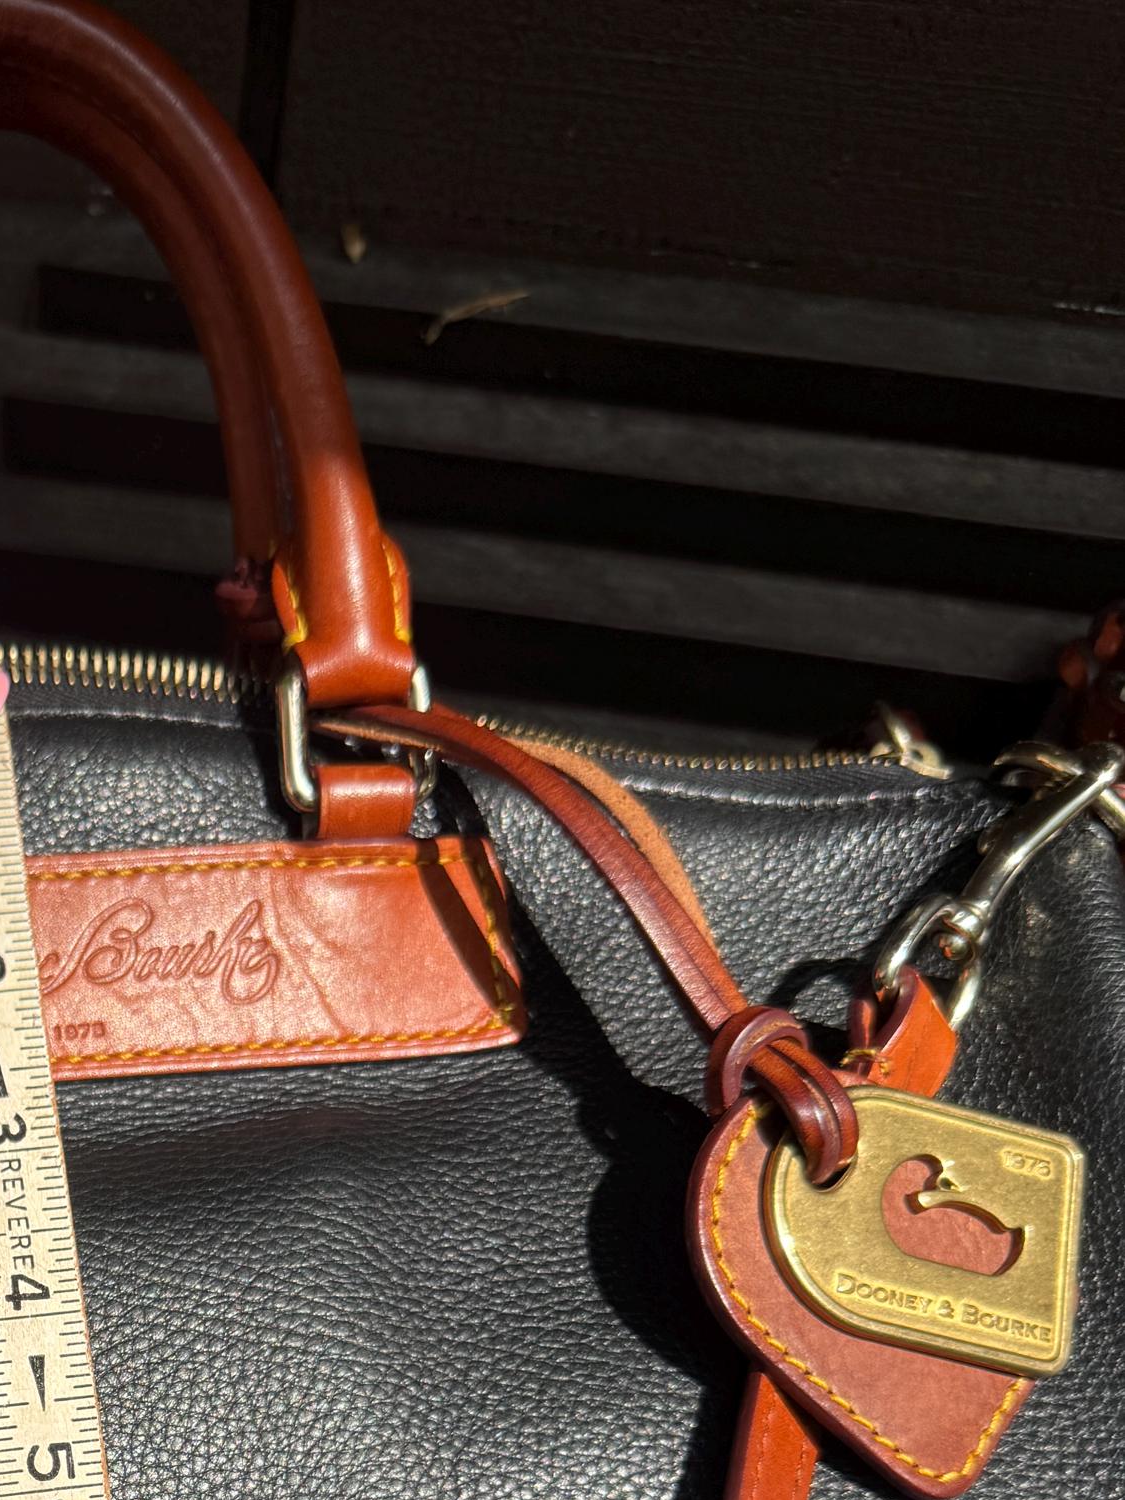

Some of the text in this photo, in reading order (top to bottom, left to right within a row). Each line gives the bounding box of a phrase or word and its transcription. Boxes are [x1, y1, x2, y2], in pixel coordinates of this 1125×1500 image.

[0, 1157, 36, 1271] REVERE
[5, 1273, 51, 1312] 4
[937, 1298, 956, 1320] &
[26, 1442, 76, 1482] 5
